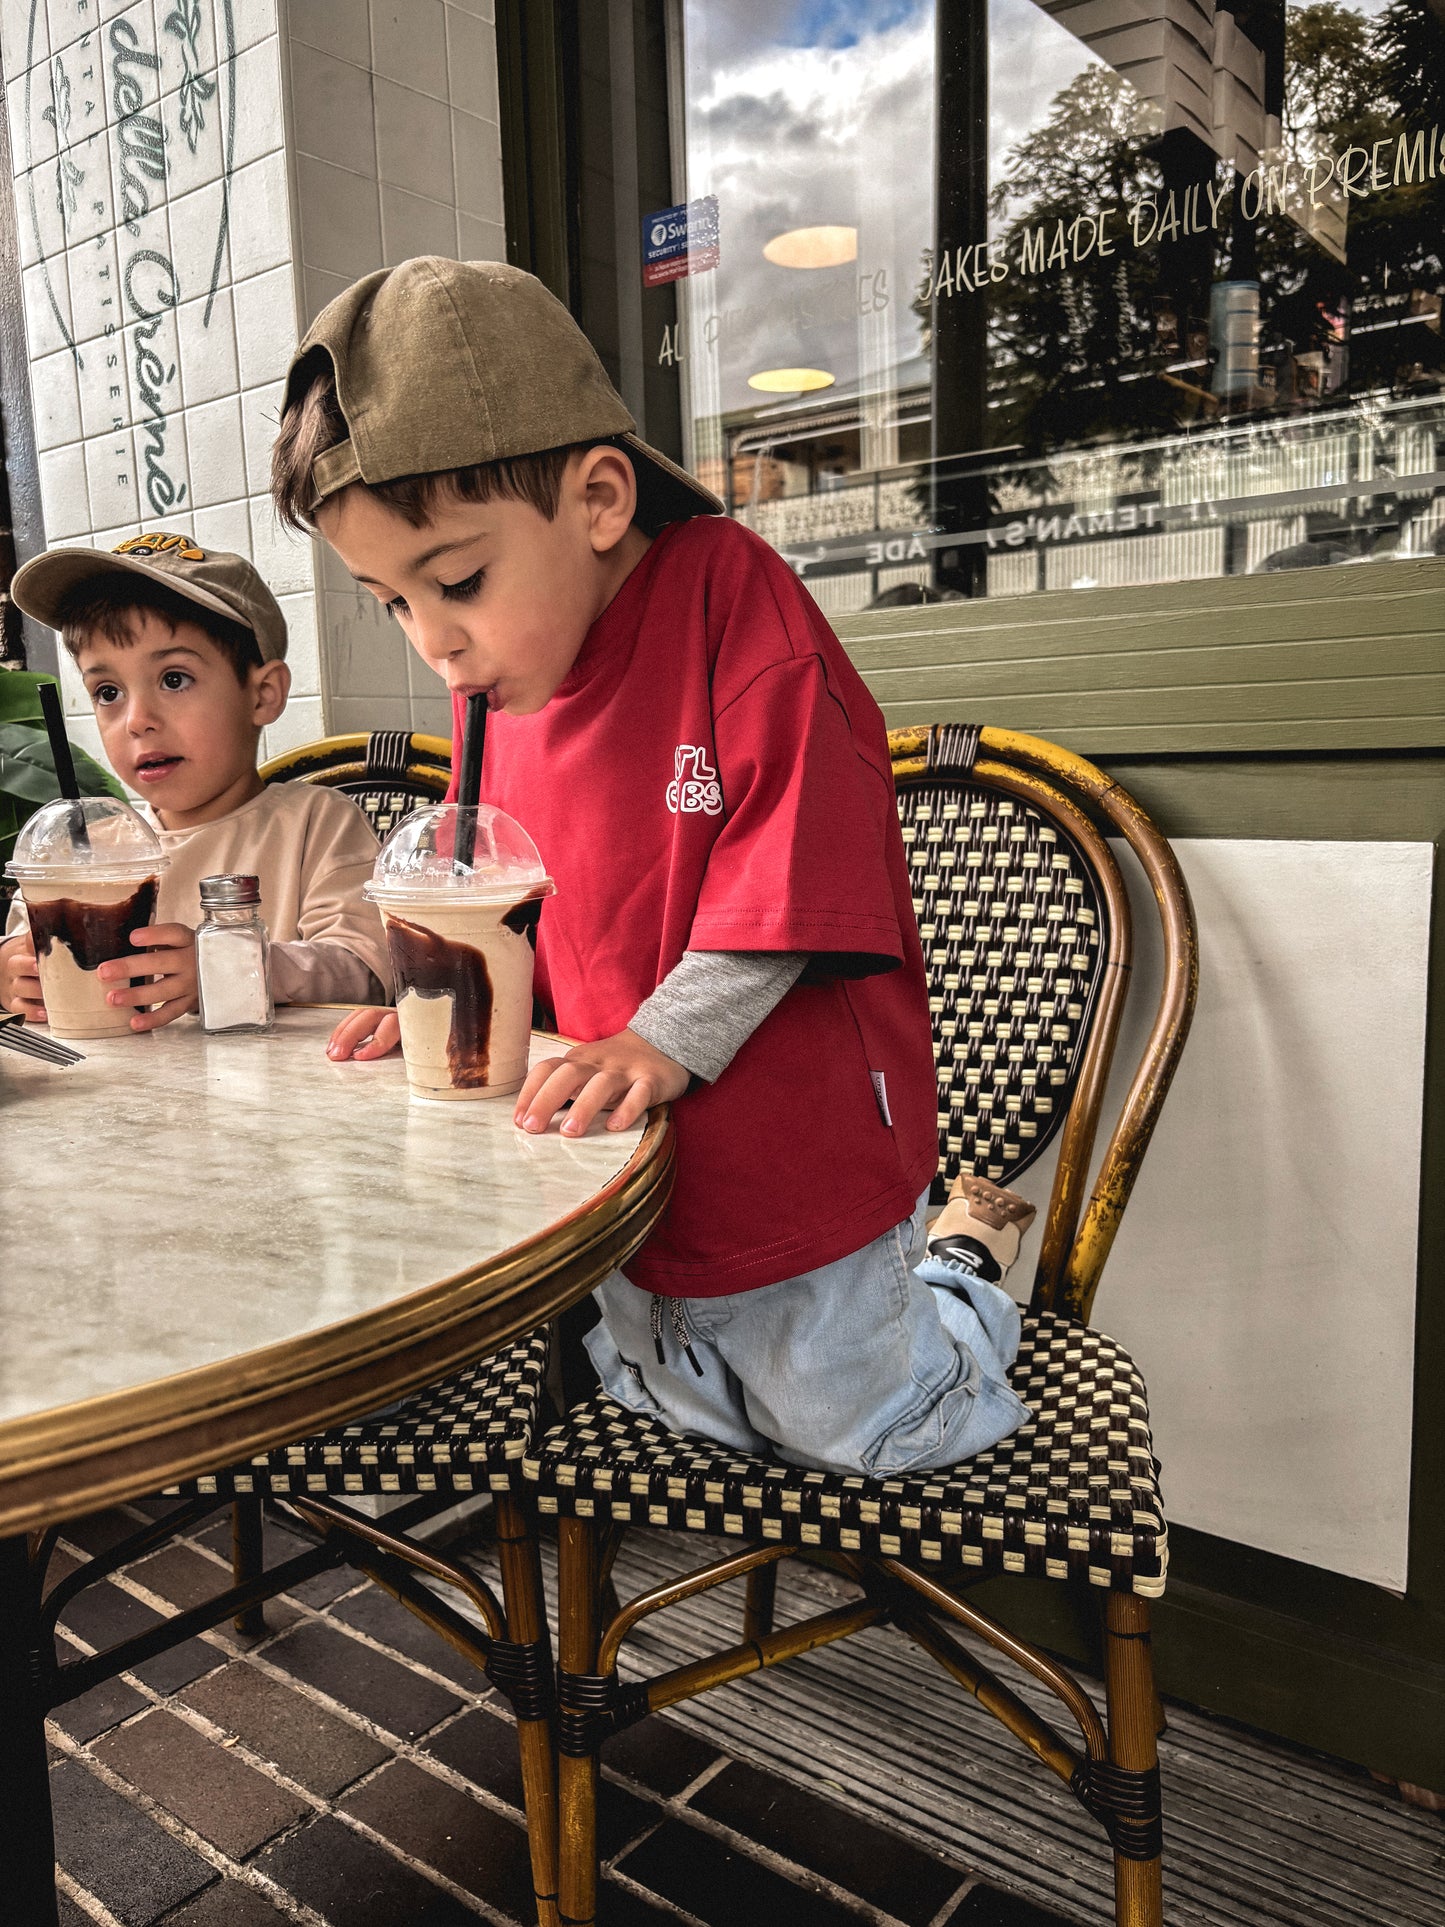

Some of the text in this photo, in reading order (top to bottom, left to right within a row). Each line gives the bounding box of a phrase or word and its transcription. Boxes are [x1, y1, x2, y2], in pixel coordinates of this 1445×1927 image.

[109, 18, 171, 237] della
[647, 244, 678, 259] SECURITY
[1020, 208, 1117, 275] MADE
[1127, 178, 1231, 248] DAILY
[1241, 162, 1290, 221] ON
[93, 201, 128, 486] PATISSERIE
